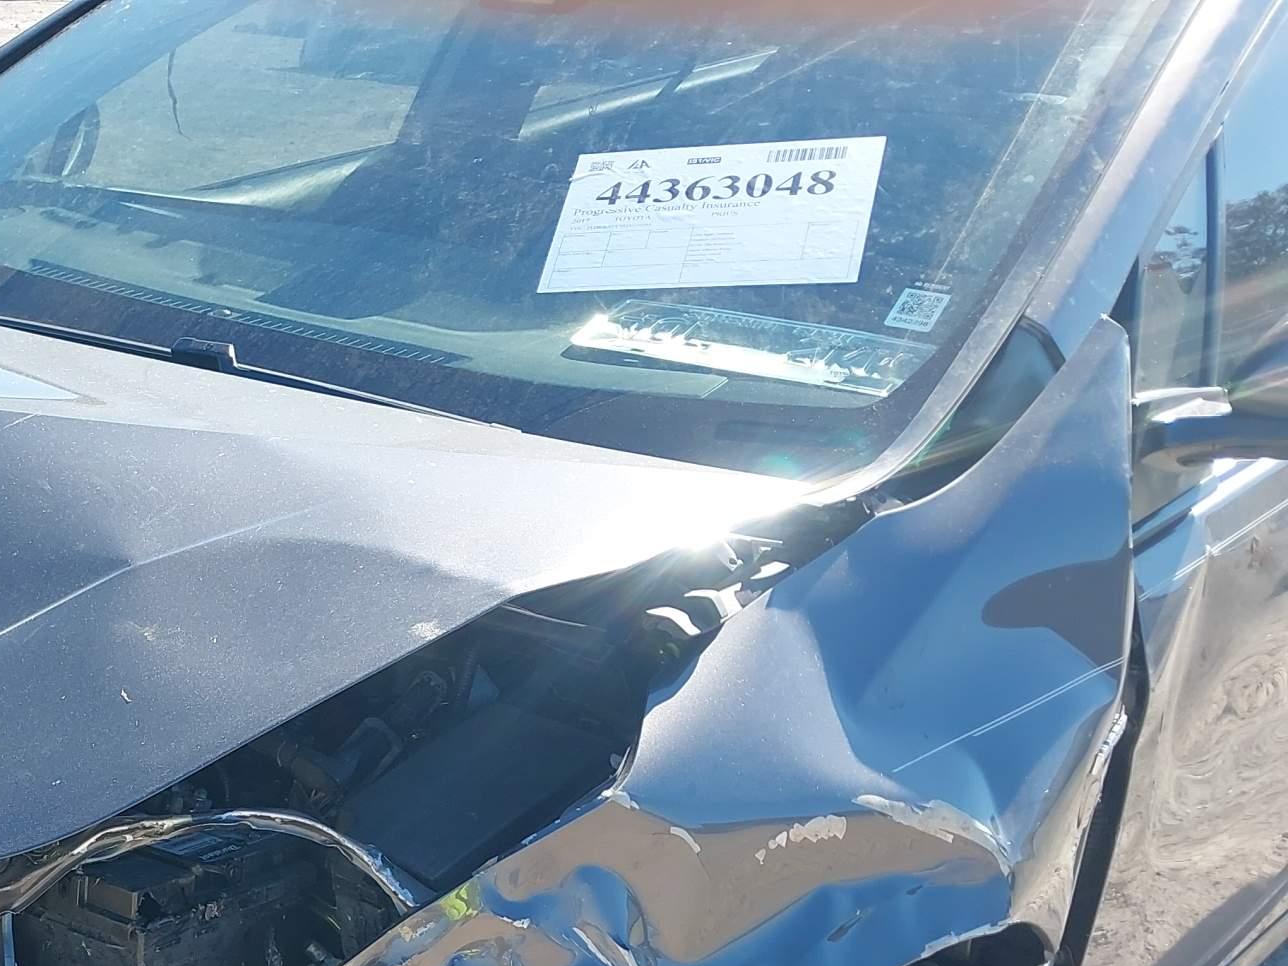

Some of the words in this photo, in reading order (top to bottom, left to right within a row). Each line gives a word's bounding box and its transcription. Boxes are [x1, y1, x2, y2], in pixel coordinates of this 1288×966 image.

[595, 169, 837, 205] 44363048
[574, 205, 641, 217] Progressive
[645, 202, 697, 213] Casualty
[702, 201, 761, 209] Insurance
